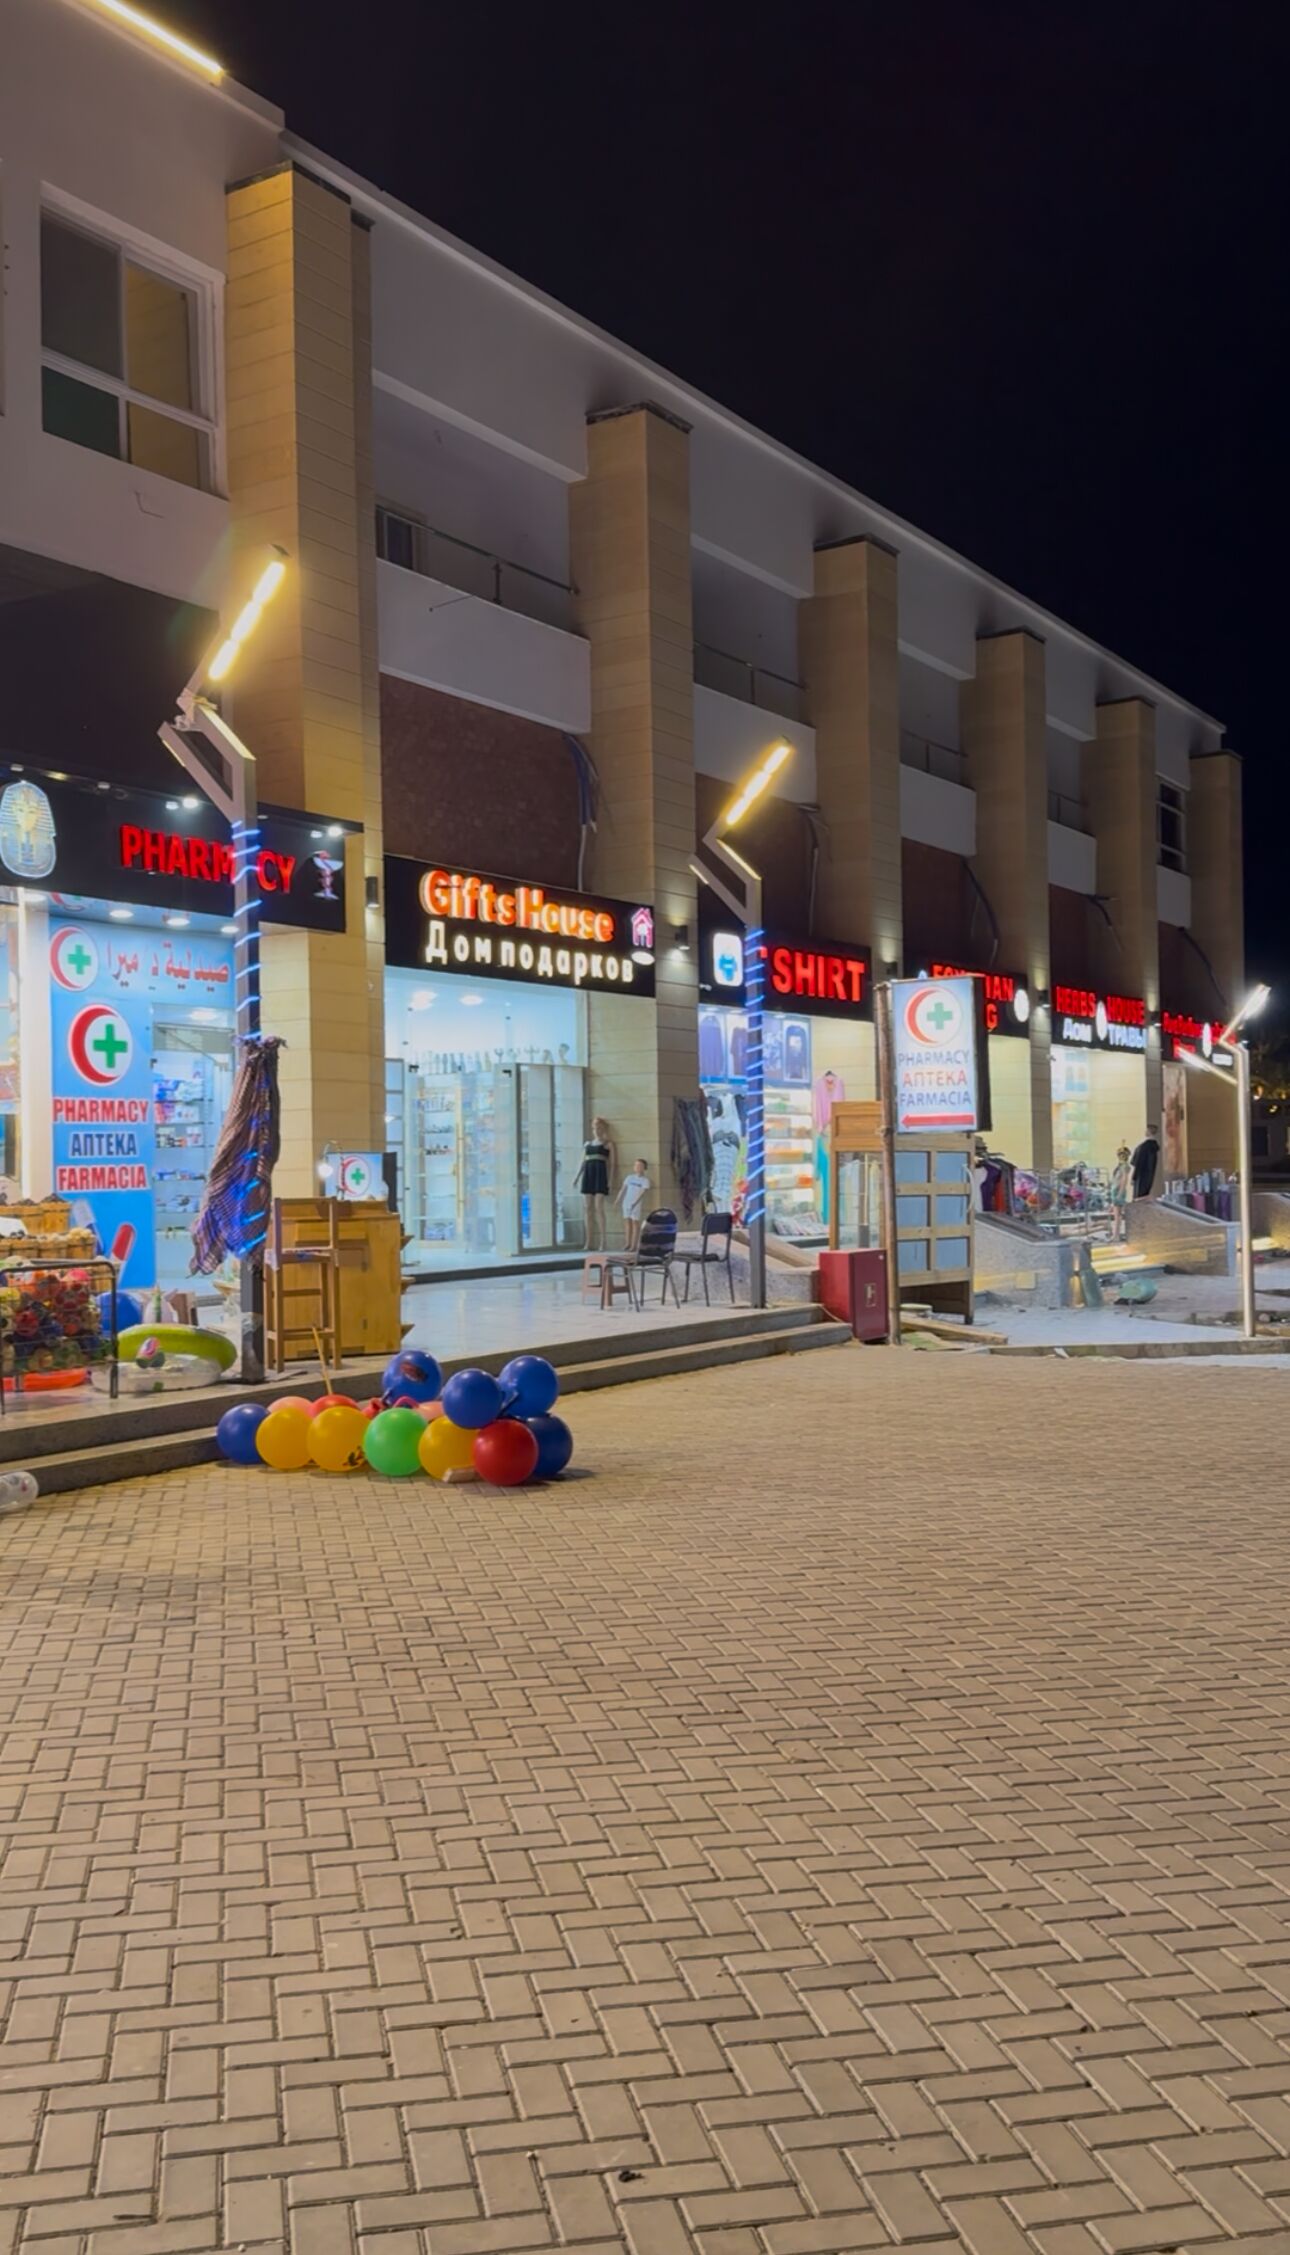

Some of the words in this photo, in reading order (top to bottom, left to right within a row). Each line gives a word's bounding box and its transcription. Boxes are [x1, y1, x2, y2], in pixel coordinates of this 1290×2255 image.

[120, 824, 297, 894] PHARMCY
[419, 869, 516, 926] Gifts
[514, 886, 614, 943] House
[425, 919, 492, 965] Дом
[499, 940, 633, 985] подарков
[772, 947, 865, 1002] SHIRT
[1056, 986, 1096, 1018] HERBS
[1107, 995, 1145, 1025] HOUSE
[898, 1050, 970, 1066] PHARMACY
[903, 1070, 967, 1088] АПТЕКА
[53, 1098, 149, 1123] PHARMACY
[899, 1091, 973, 1107] FARMACIA
[71, 1133, 138, 1157] АПТЕКА
[58, 1165, 147, 1191] FARMACIA
